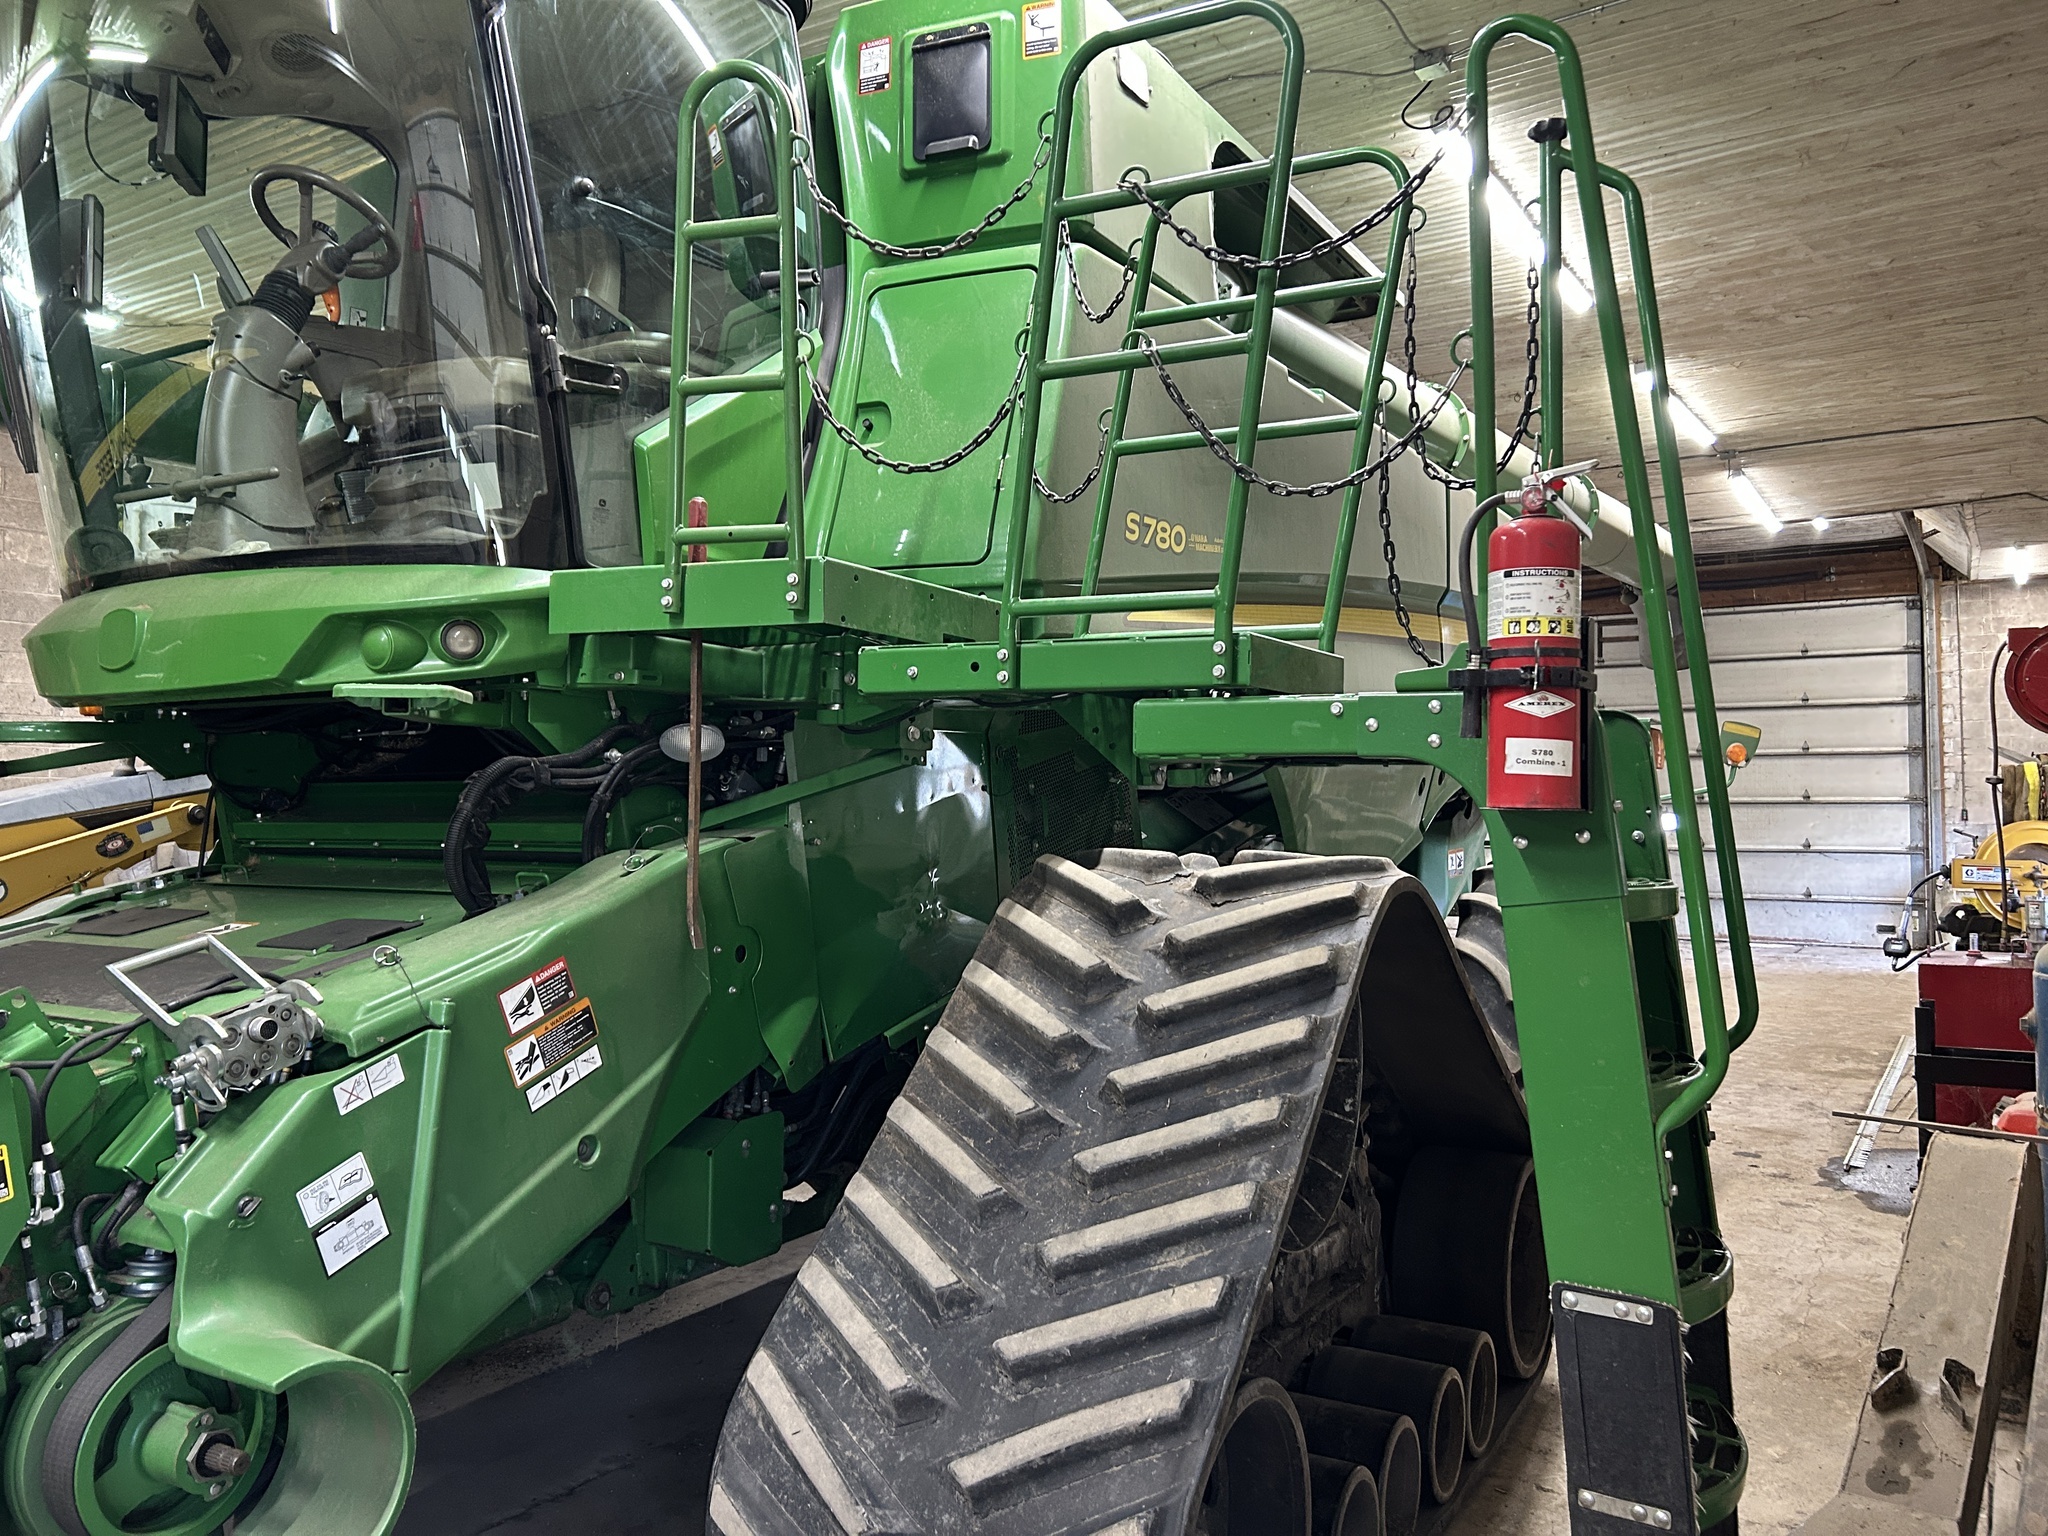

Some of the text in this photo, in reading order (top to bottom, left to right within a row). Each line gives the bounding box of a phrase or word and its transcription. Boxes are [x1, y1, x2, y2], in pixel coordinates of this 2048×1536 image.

[1030, 2, 1055, 10] WARNIN
[866, 37, 889, 48] DANGER
[1125, 511, 1187, 554] S780
[1511, 569, 1569, 577] INSTRUCTIONS
[1515, 757, 1556, 766] Combine
[539, 961, 565, 980] DANGER
[549, 1007, 576, 1028] WARNING
